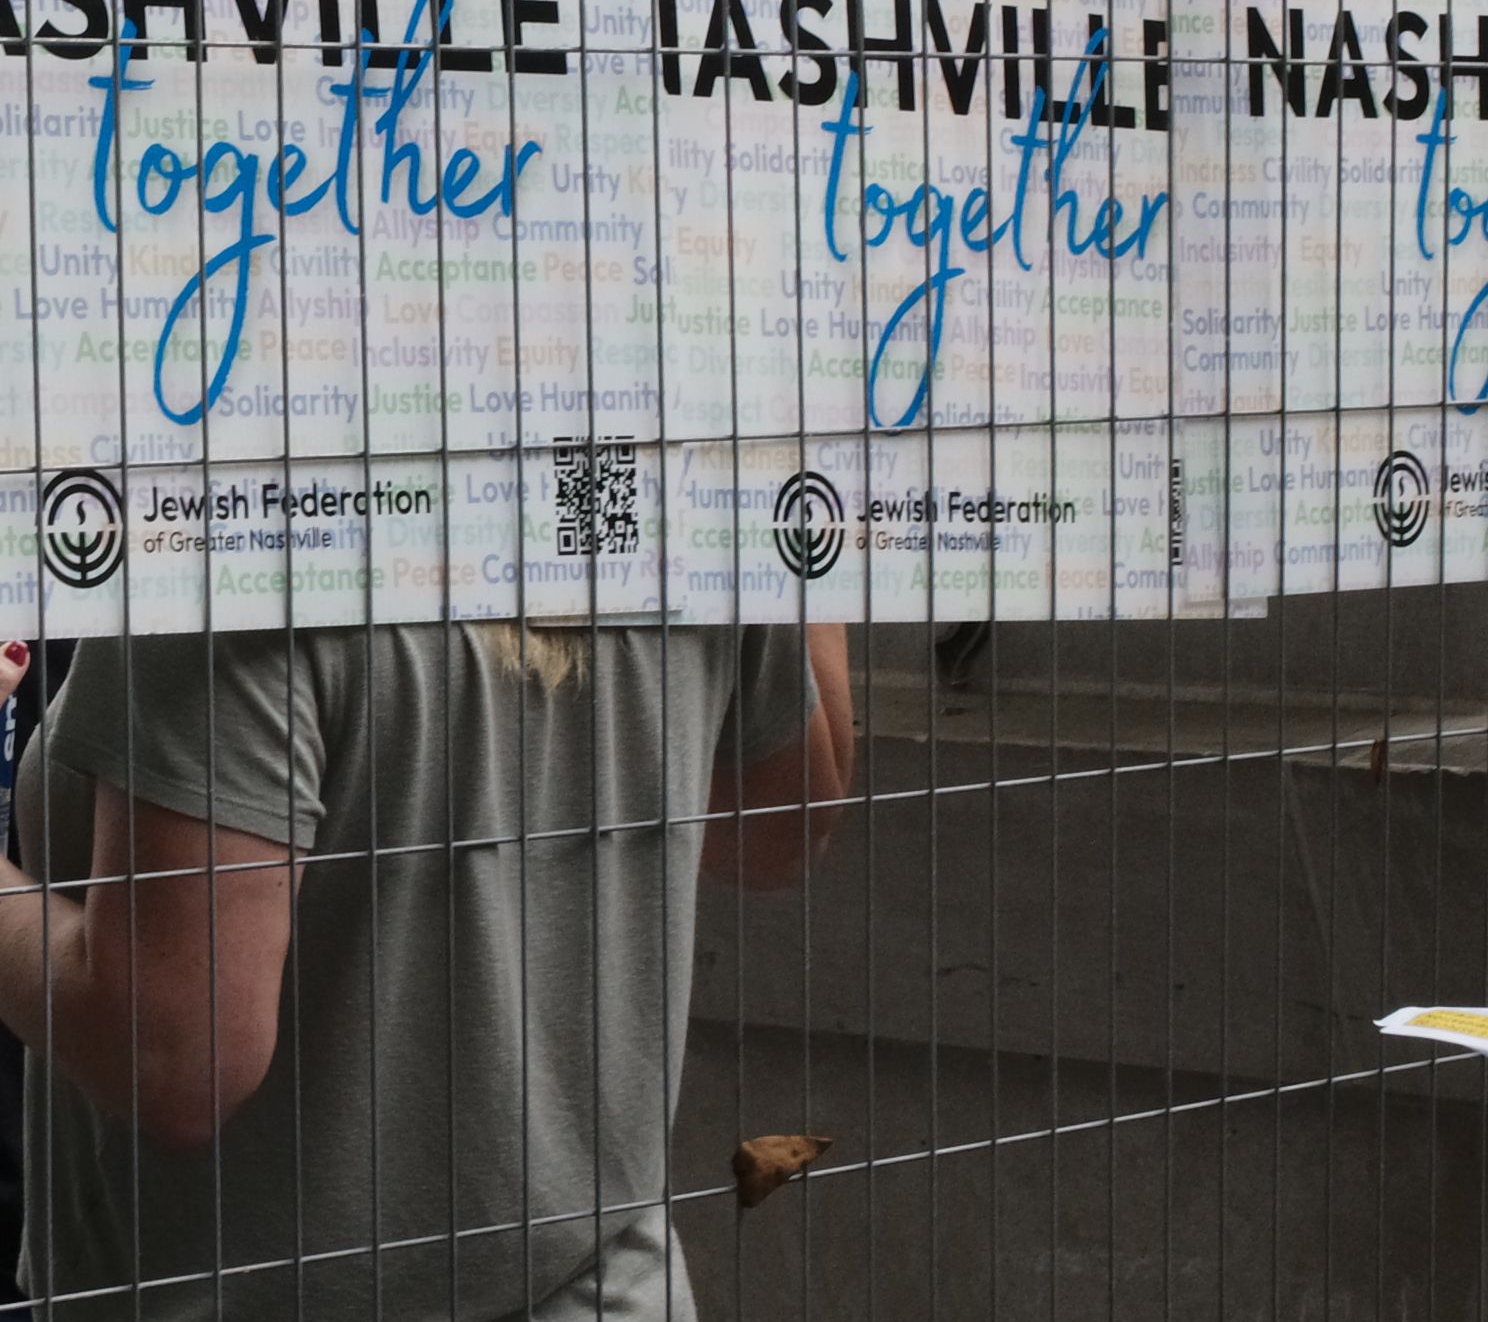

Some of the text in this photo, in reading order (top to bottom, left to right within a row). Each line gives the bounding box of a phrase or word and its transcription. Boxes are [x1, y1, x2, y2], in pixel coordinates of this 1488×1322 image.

[821, 27, 1169, 433] together
[218, 380, 665, 425] Solidarity Love Humanity
[262, 480, 432, 521] Federation
[948, 491, 1076, 524] Federation
[143, 531, 165, 553] of
[169, 529, 244, 553] Greater
